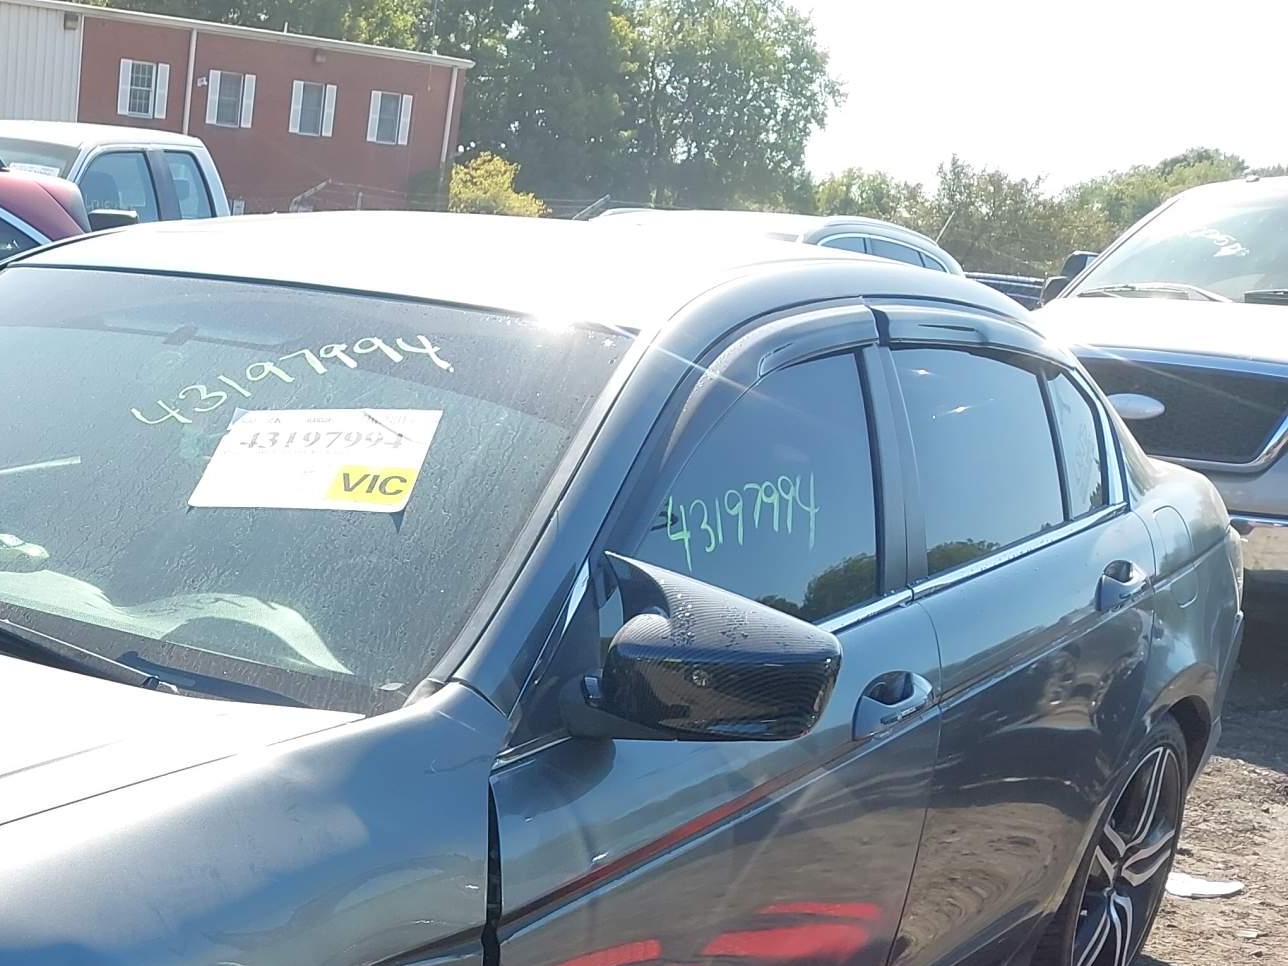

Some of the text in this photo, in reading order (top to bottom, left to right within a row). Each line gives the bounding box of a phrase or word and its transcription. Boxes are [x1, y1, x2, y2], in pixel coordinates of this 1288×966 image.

[130, 334, 455, 425] 43197994
[342, 472, 408, 496] VIC
[667, 471, 821, 572] 43197994
